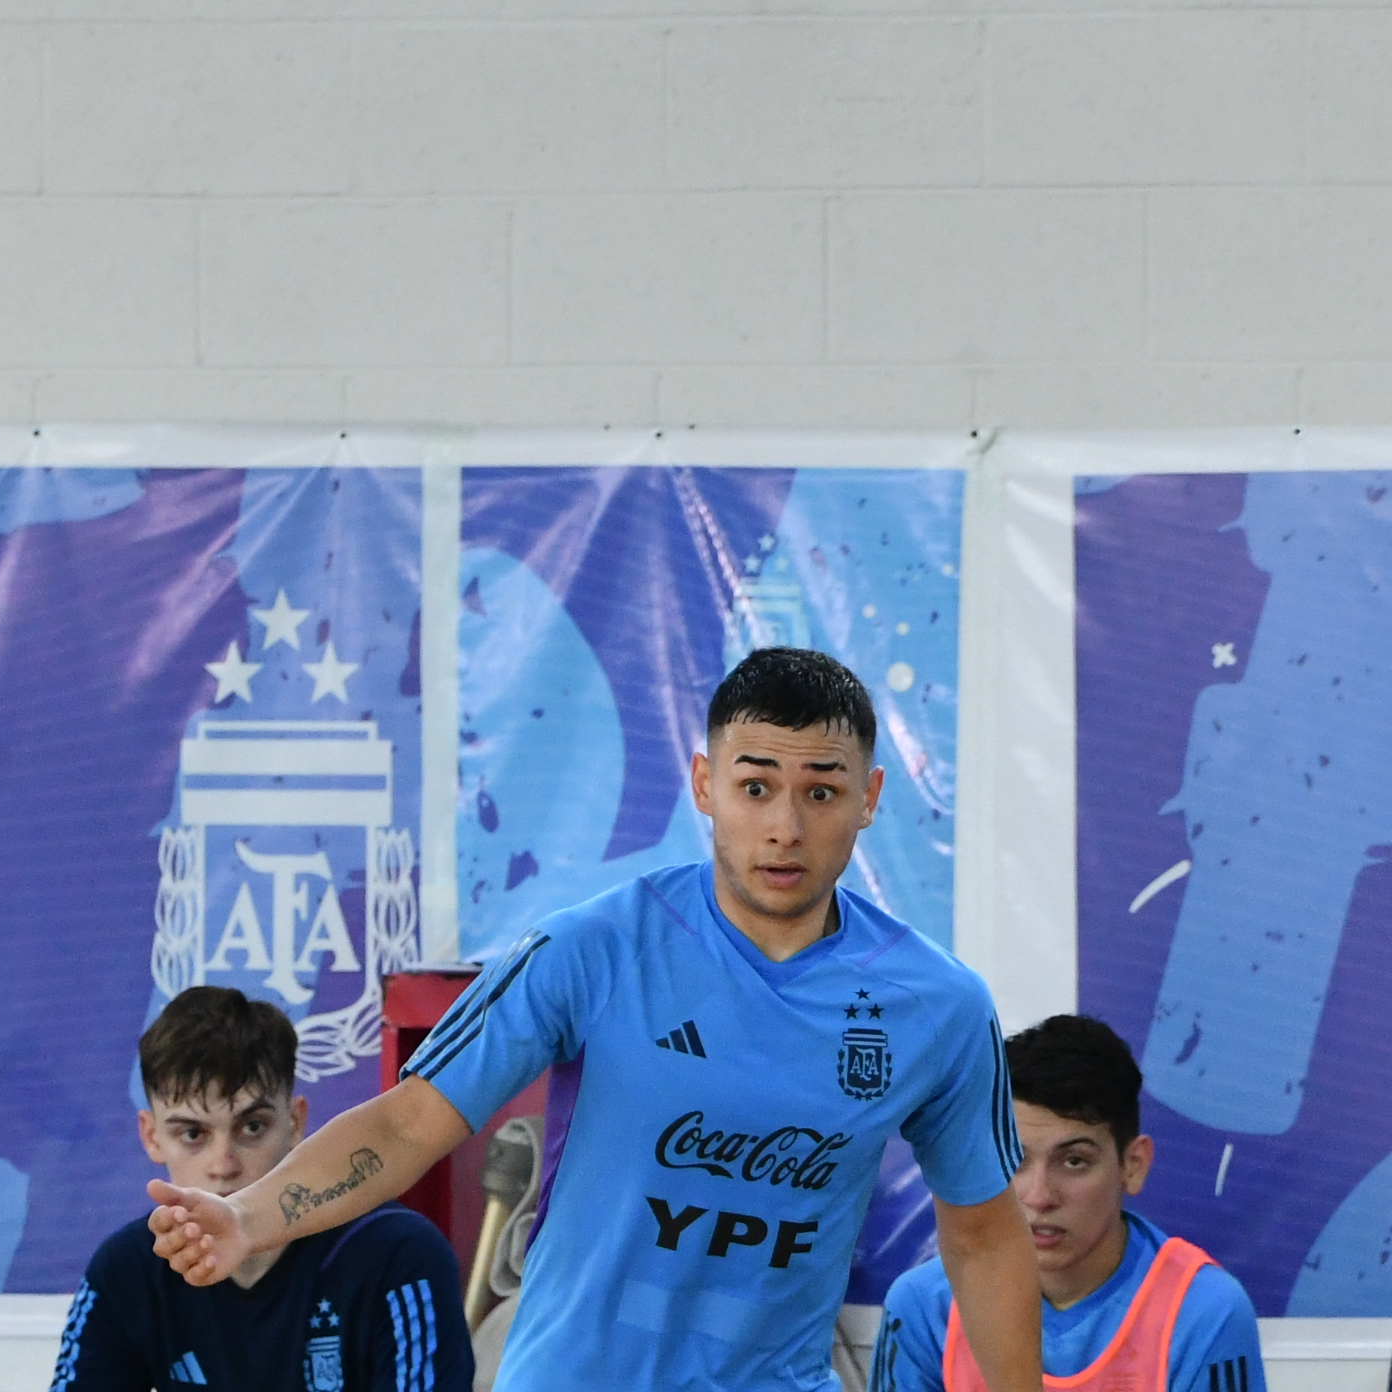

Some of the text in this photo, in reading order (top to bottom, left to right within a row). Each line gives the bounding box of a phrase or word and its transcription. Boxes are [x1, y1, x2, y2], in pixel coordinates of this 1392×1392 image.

[205, 838, 363, 1005] AFA
[849, 1046, 880, 1081] AFA
[654, 1109, 855, 1191] Coca-Cola
[644, 1195, 819, 1269] YPF
